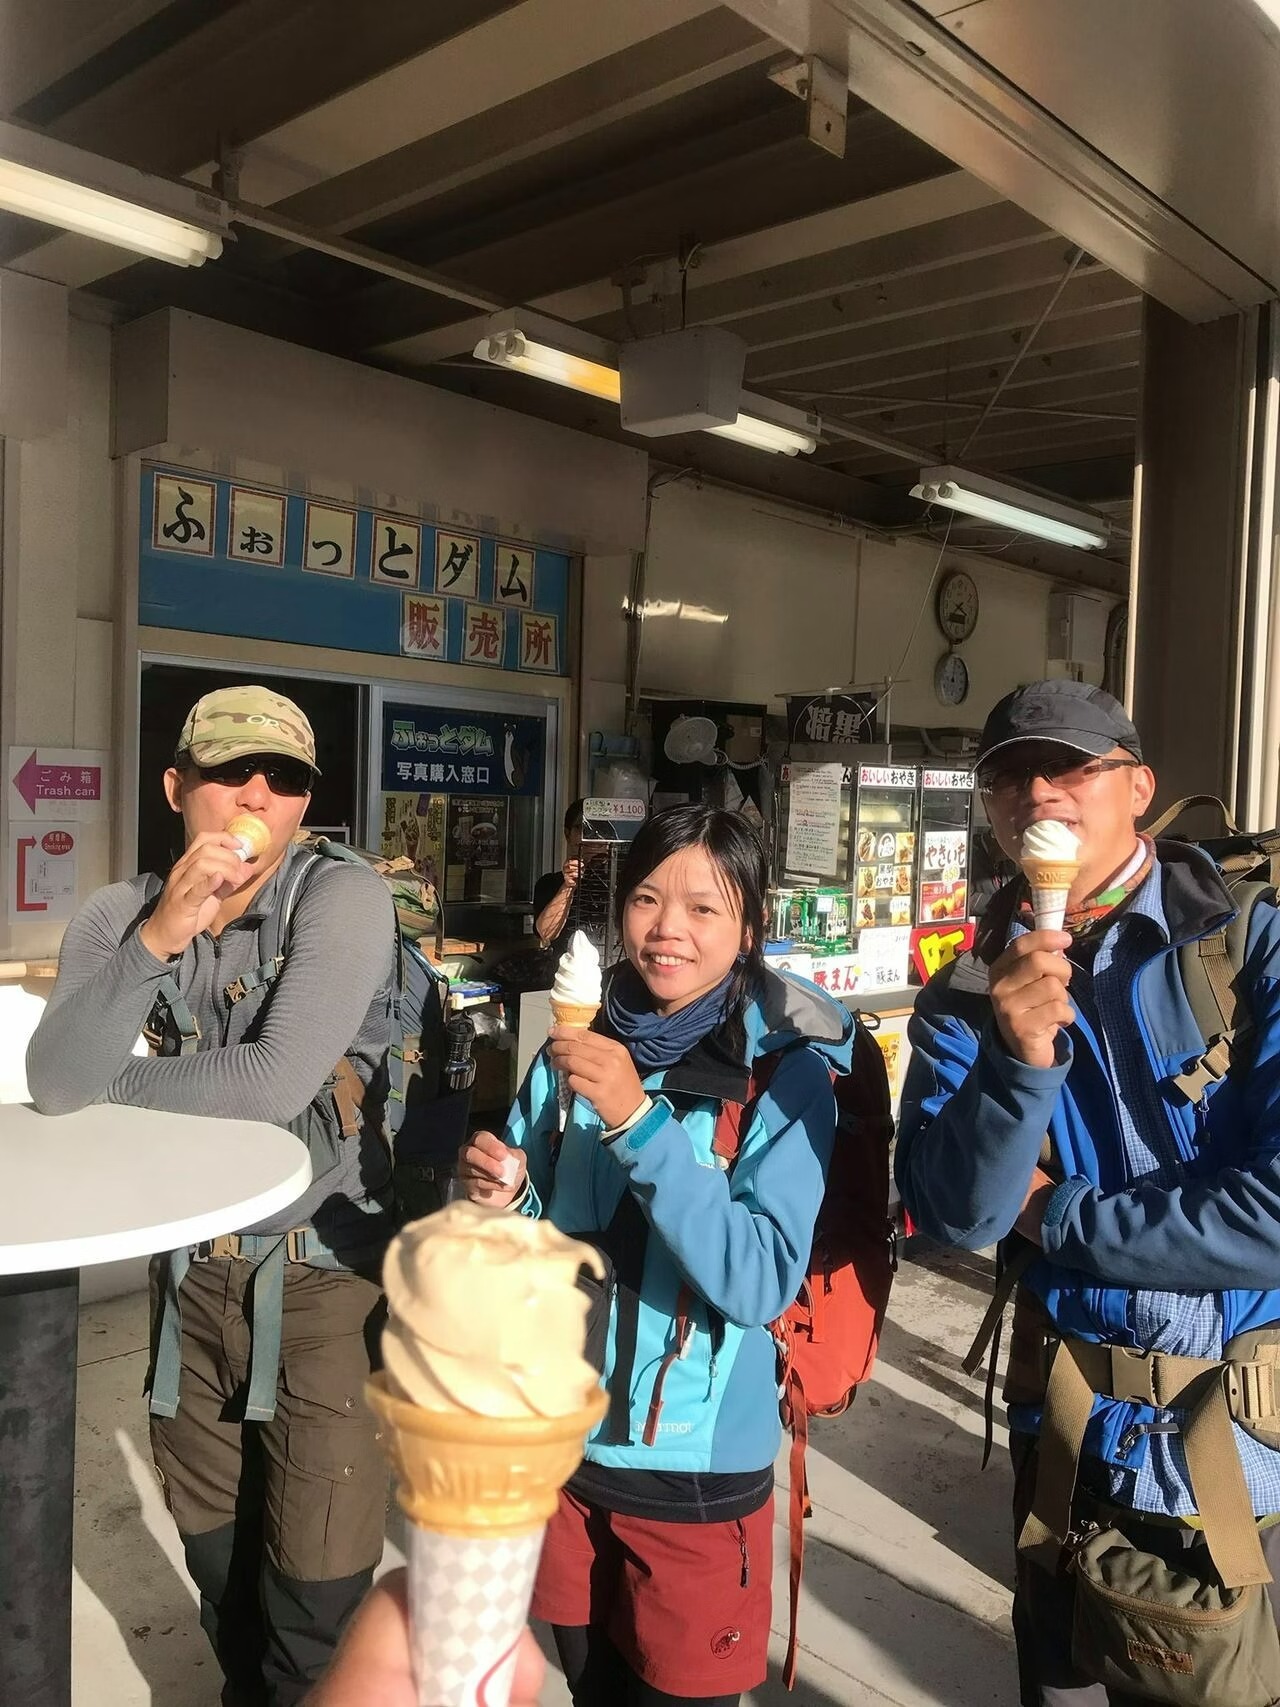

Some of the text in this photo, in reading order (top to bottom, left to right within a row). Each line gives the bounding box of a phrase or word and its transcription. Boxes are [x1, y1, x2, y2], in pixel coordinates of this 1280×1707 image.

[163, 486, 528, 602] ふぉっとダム
[408, 600, 552, 666] 販売所
[391, 720, 494, 756] ふぉっとダム
[40, 769, 92, 784] ごみ箱
[397, 761, 490, 784] 写真購入窓口
[861, 769, 915, 786] おいしいおやき
[925, 773, 974, 788] おいしいおやき
[36, 784, 95, 796] Trash can
[925, 842, 966, 868] やきいも
